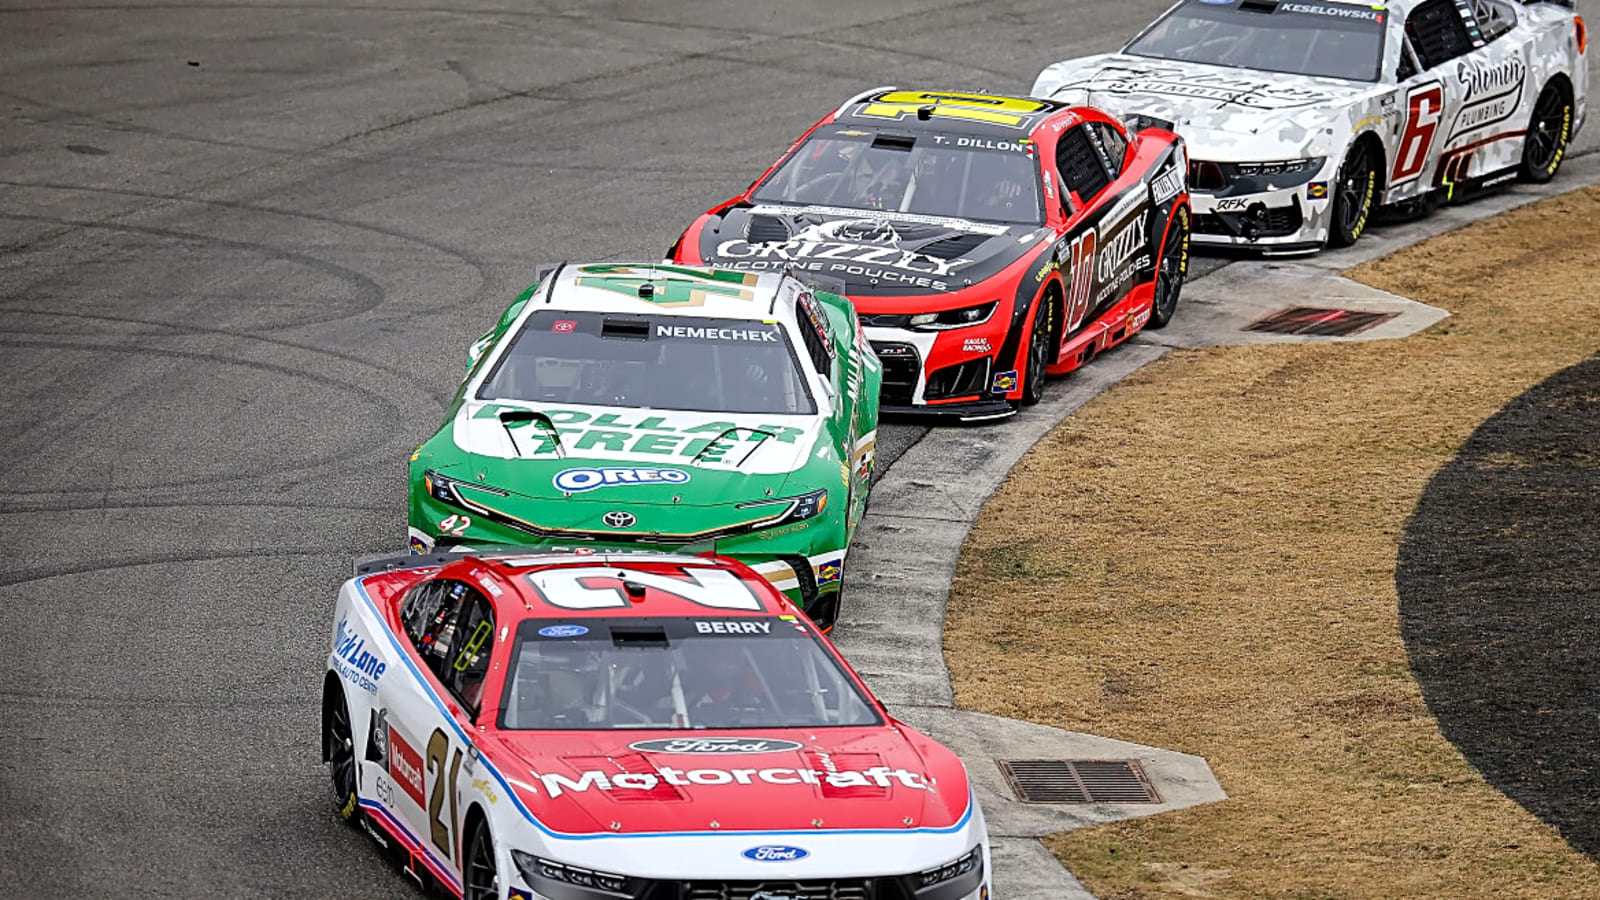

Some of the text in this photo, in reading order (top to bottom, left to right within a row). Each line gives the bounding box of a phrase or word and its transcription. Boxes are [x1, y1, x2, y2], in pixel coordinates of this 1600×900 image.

[1281, 3, 1376, 20] KESELOWSKI
[1460, 101, 1506, 128] PLUMBING
[934, 136, 1023, 152] T. DILLON
[1390, 87, 1442, 182] 6
[1216, 198, 1249, 210] RFK
[717, 238, 974, 277] GRIZZLY
[1098, 209, 1149, 283] GRIZZLY
[712, 261, 949, 291] NICOTINE POUCHES
[657, 324, 777, 343] NEMECHEK
[472, 403, 805, 444] DOLLAR
[530, 427, 735, 463] TREE
[556, 469, 688, 490] OREO
[439, 514, 471, 537] 42
[695, 621, 770, 634] BERRY
[352, 639, 386, 681] Lane
[342, 666, 359, 683] AUTO
[664, 737, 769, 753] Ford
[540, 764, 928, 799] Motorcraft
[426, 727, 463, 872] 21
[754, 847, 799, 861] Ford
